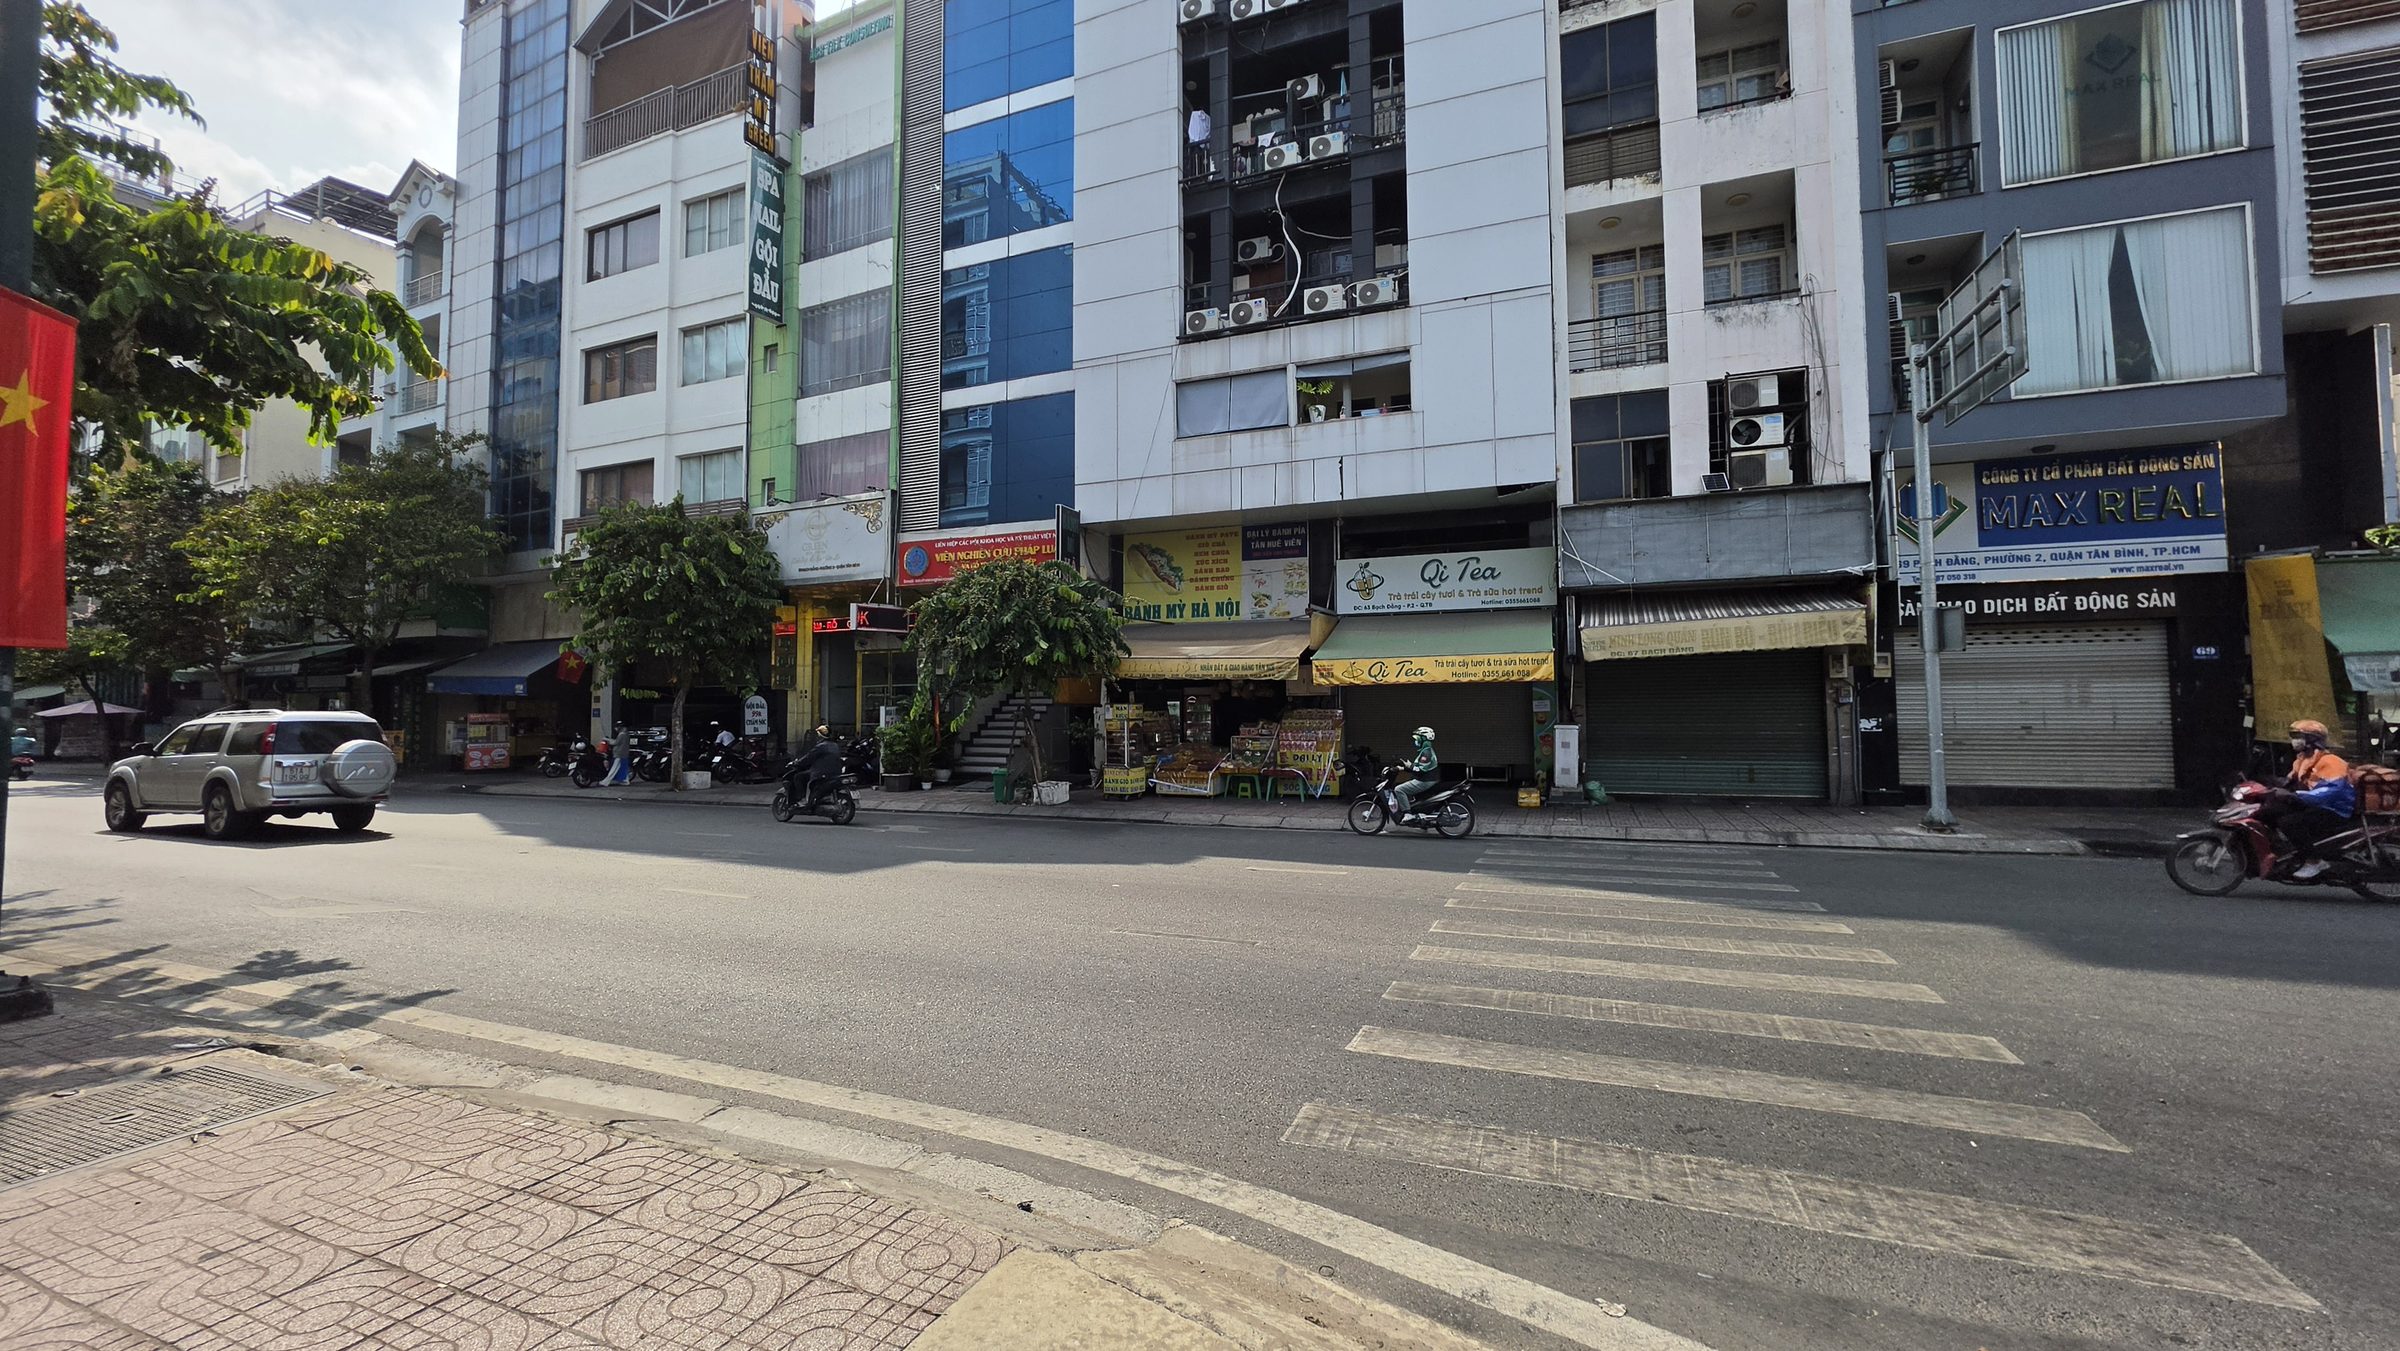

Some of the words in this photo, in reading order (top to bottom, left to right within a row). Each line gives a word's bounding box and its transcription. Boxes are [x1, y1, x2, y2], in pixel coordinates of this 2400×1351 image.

[752, 30, 776, 62] VIỆN
[747, 123, 775, 153] GREEN
[757, 167, 780, 198] SPA
[753, 201, 781, 233] NAIL
[756, 238, 777, 268] GỘI
[1982, 467, 2019, 485] CÔNG
[2024, 467, 2037, 481] TY
[2043, 461, 2061, 480] CỔ
[2108, 456, 2134, 476] BẤT
[2139, 453, 2179, 476] ĐỘNG
[2183, 451, 2215, 470] SẢN
[1982, 490, 2088, 530] MAX
[2098, 481, 2220, 524] REAL
[935, 551, 955, 563] VIỆN
[957, 547, 991, 562] NGHIÊN
[1014, 543, 1040, 557] PHÁP
[2050, 551, 2082, 562] QUẬN
[2087, 550, 2110, 559] TÂN
[2152, 545, 2200, 557] TP.HCM
[1421, 558, 1449, 588] Qi
[1457, 556, 1501, 582] Tea
[1963, 573, 1976, 581] 318
[2136, 563, 2184, 572] maxreal.vn
[1388, 592, 1402, 601] Trà
[1404, 592, 1419, 600] trái
[1421, 591, 1436, 601] cây
[1468, 589, 1481, 597] Trà
[1484, 587, 1500, 596] sữa
[1501, 586, 1517, 595] hot
[1519, 586, 1543, 595] trend
[1984, 597, 2027, 615] DỊCH
[2034, 591, 2068, 612] BẤT
[2074, 591, 2129, 612] ĐỘNG
[2137, 588, 2176, 608] SẢN
[1191, 598, 1210, 618] HÀ
[1215, 597, 1241, 620] NỘI
[2196, 647, 2216, 655] 69
[1368, 661, 1390, 682] Qi
[1395, 660, 1428, 678] Tea
[1434, 659, 1445, 668] Trà
[1457, 659, 1469, 669] cây
[1493, 658, 1502, 667] trà
[1518, 657, 1530, 666] hot
[1530, 657, 1548, 665] trend
[1451, 670, 1480, 678] Hotline:
[1482, 669, 1498, 678] 0355
[1499, 669, 1514, 677] 661
[1516, 669, 1530, 677] 088
